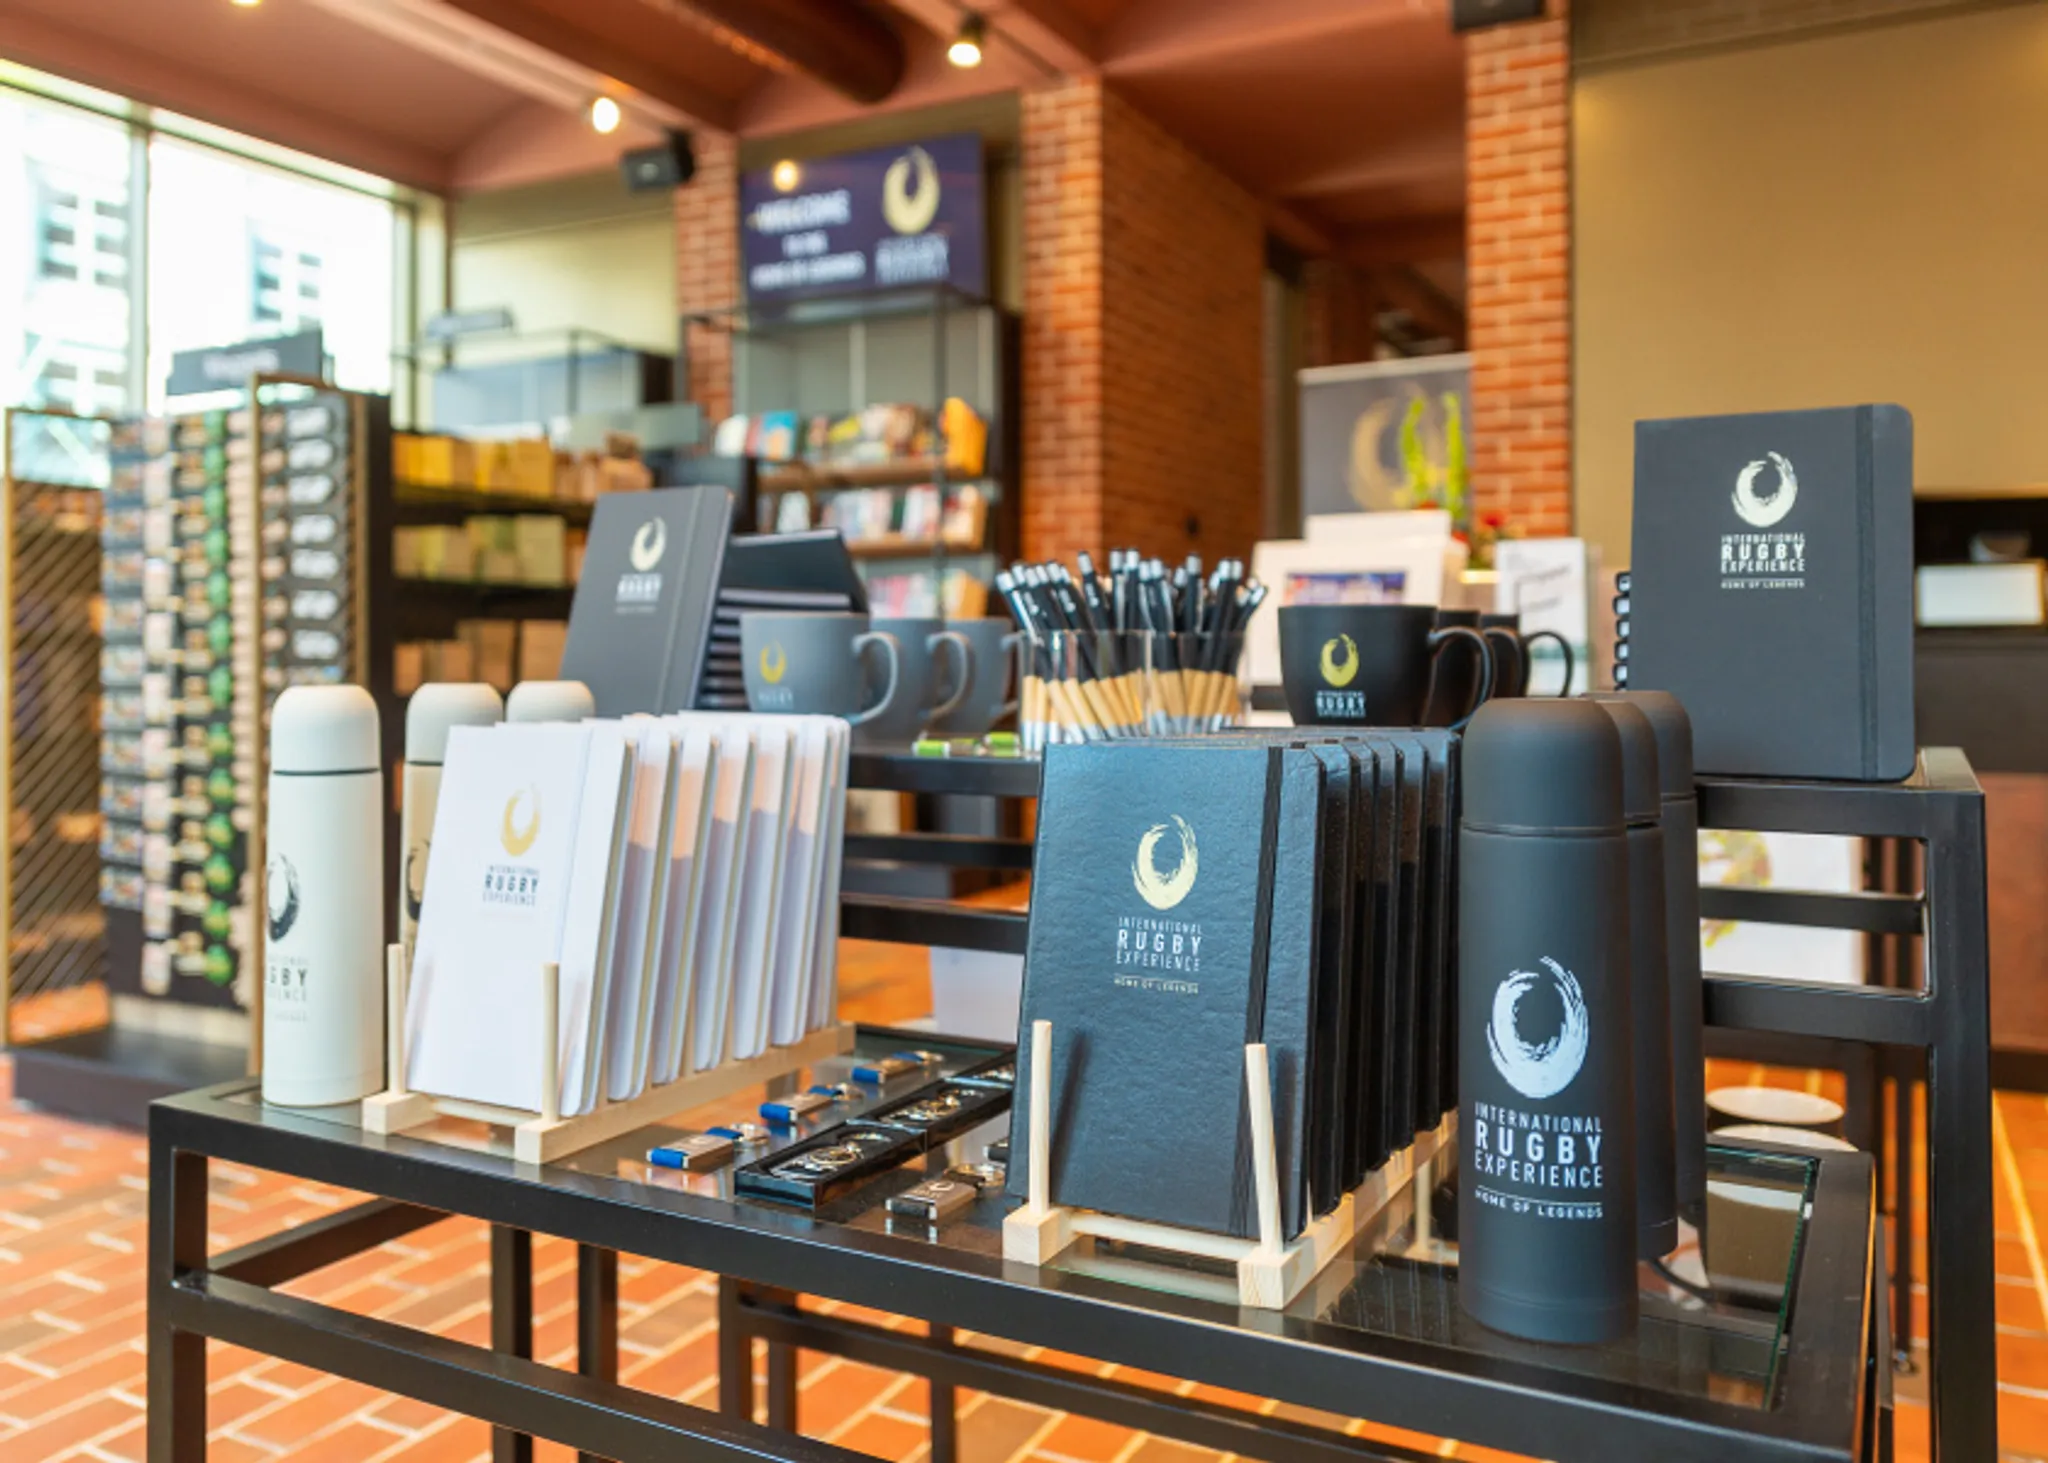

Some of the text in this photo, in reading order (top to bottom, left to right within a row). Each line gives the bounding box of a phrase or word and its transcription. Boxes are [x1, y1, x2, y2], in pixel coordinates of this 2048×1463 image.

[1721, 532, 1805, 545] INTERNATIONAL
[1721, 543, 1805, 560] RUGBY
[1721, 558, 1805, 574] EXPERIENCE
[485, 874, 538, 893] RUGBY
[1118, 916, 1202, 935] INTERNATIONAL
[1117, 928, 1202, 956] RUGBY
[1116, 949, 1201, 972] EXPERIENCE
[1475, 1101, 1603, 1133] INTERNATIONAL
[1475, 1119, 1601, 1164] RUGBY
[1475, 1149, 1603, 1188] EXPERIENCE
[1475, 1189, 1603, 1219] HOME OF LEGENDS
